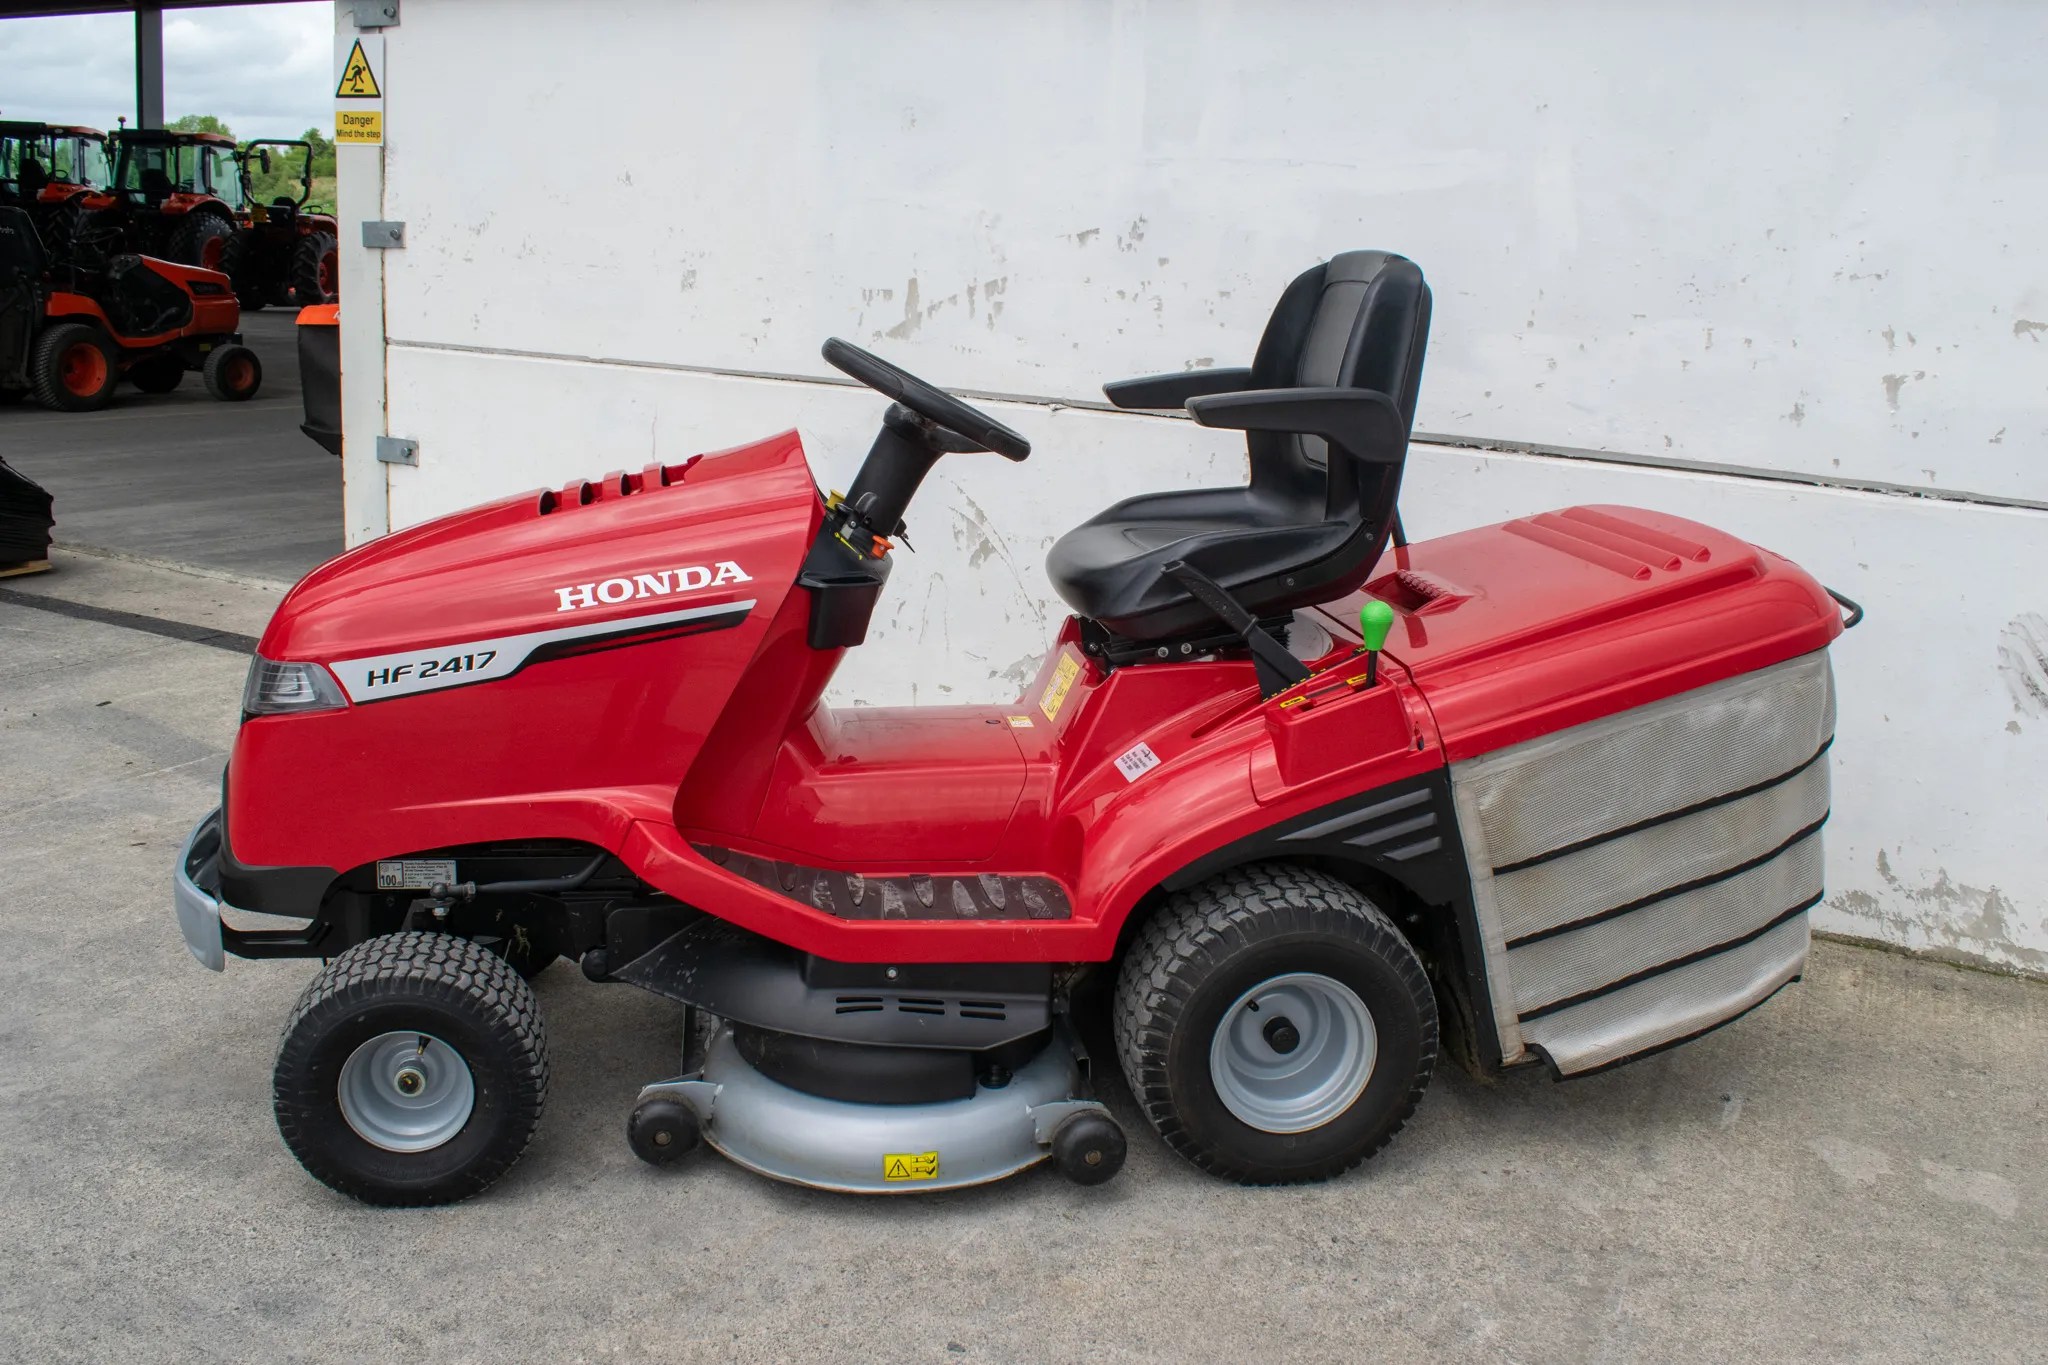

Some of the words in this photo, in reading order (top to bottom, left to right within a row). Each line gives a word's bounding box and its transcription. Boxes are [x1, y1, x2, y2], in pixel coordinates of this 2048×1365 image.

[343, 114, 374, 127] Danger
[336, 129, 352, 137] Mind
[354, 129, 365, 137] the
[366, 130, 381, 139] step
[554, 560, 753, 612] HONDA
[367, 663, 414, 687] HF
[419, 650, 498, 679] 2417
[381, 874, 396, 886] 100
